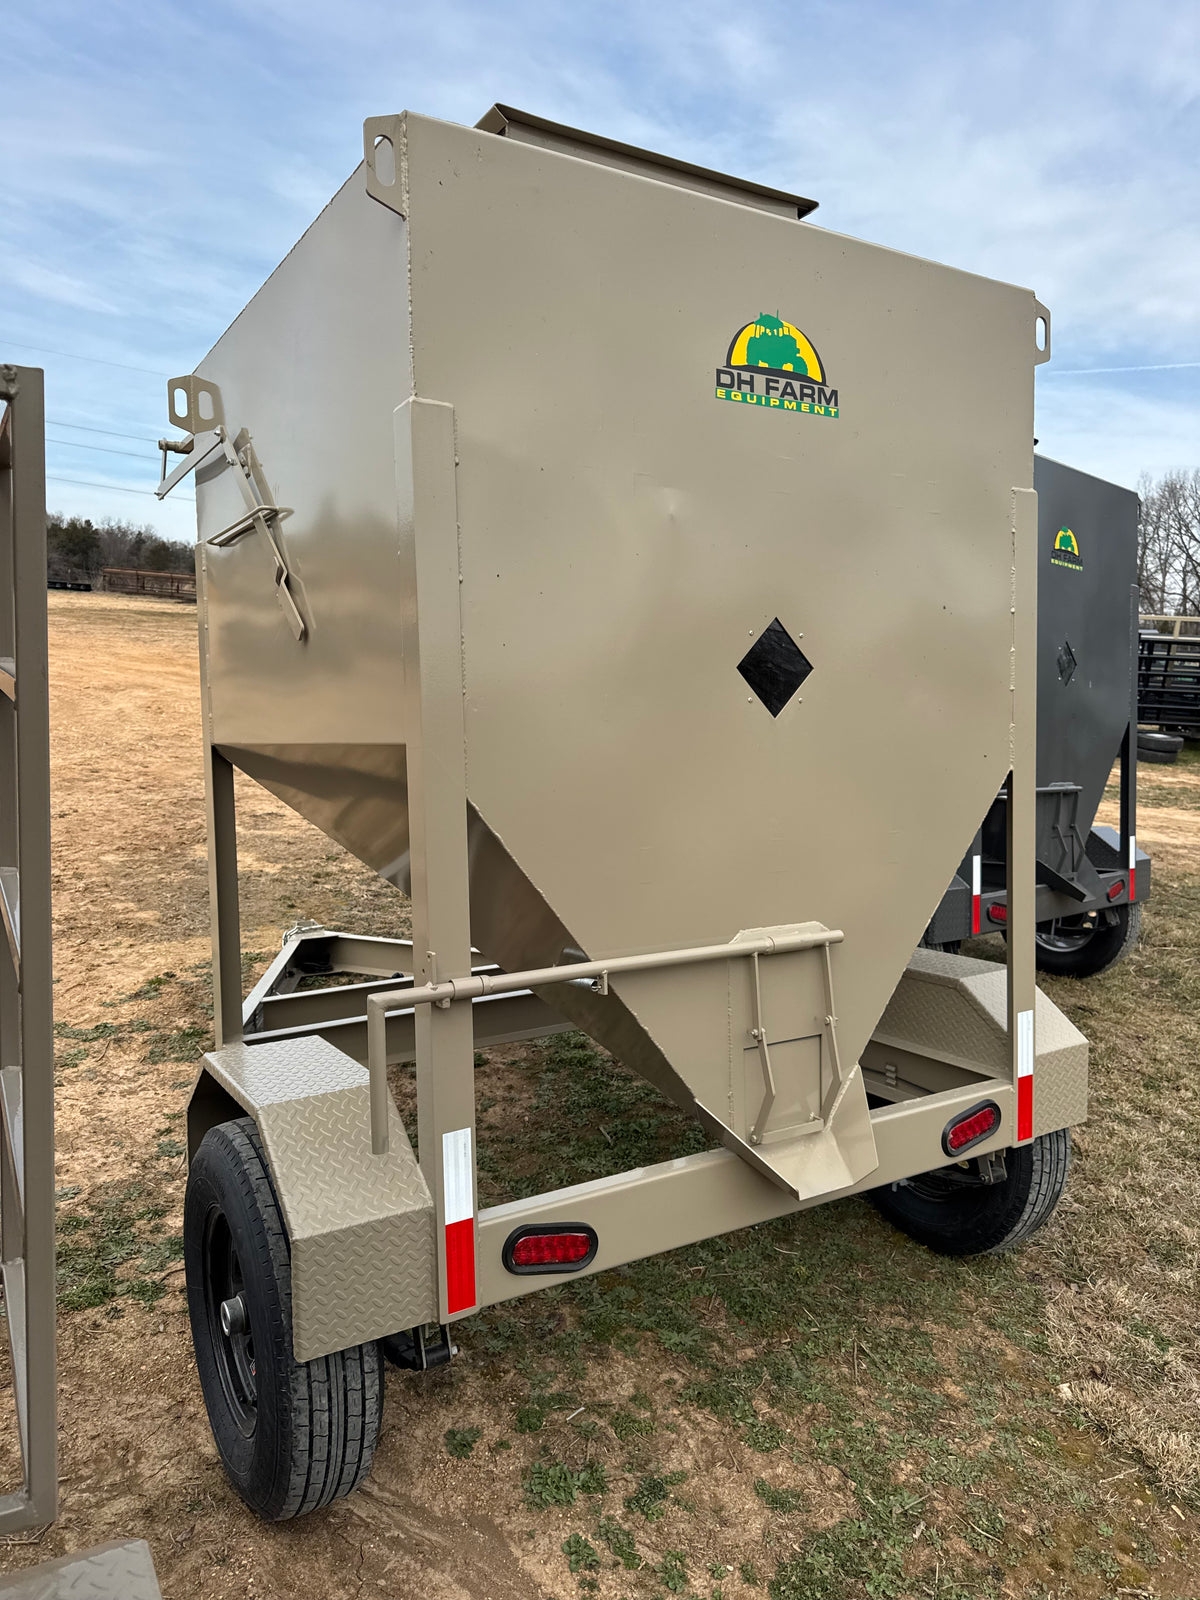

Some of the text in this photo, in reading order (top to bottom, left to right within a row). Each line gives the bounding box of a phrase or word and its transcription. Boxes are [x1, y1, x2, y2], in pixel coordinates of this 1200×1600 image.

[716, 368, 839, 407] DH FARM
[716, 388, 838, 417] EQUIPMENT
[1050, 558, 1084, 572] EQUIPMENT
